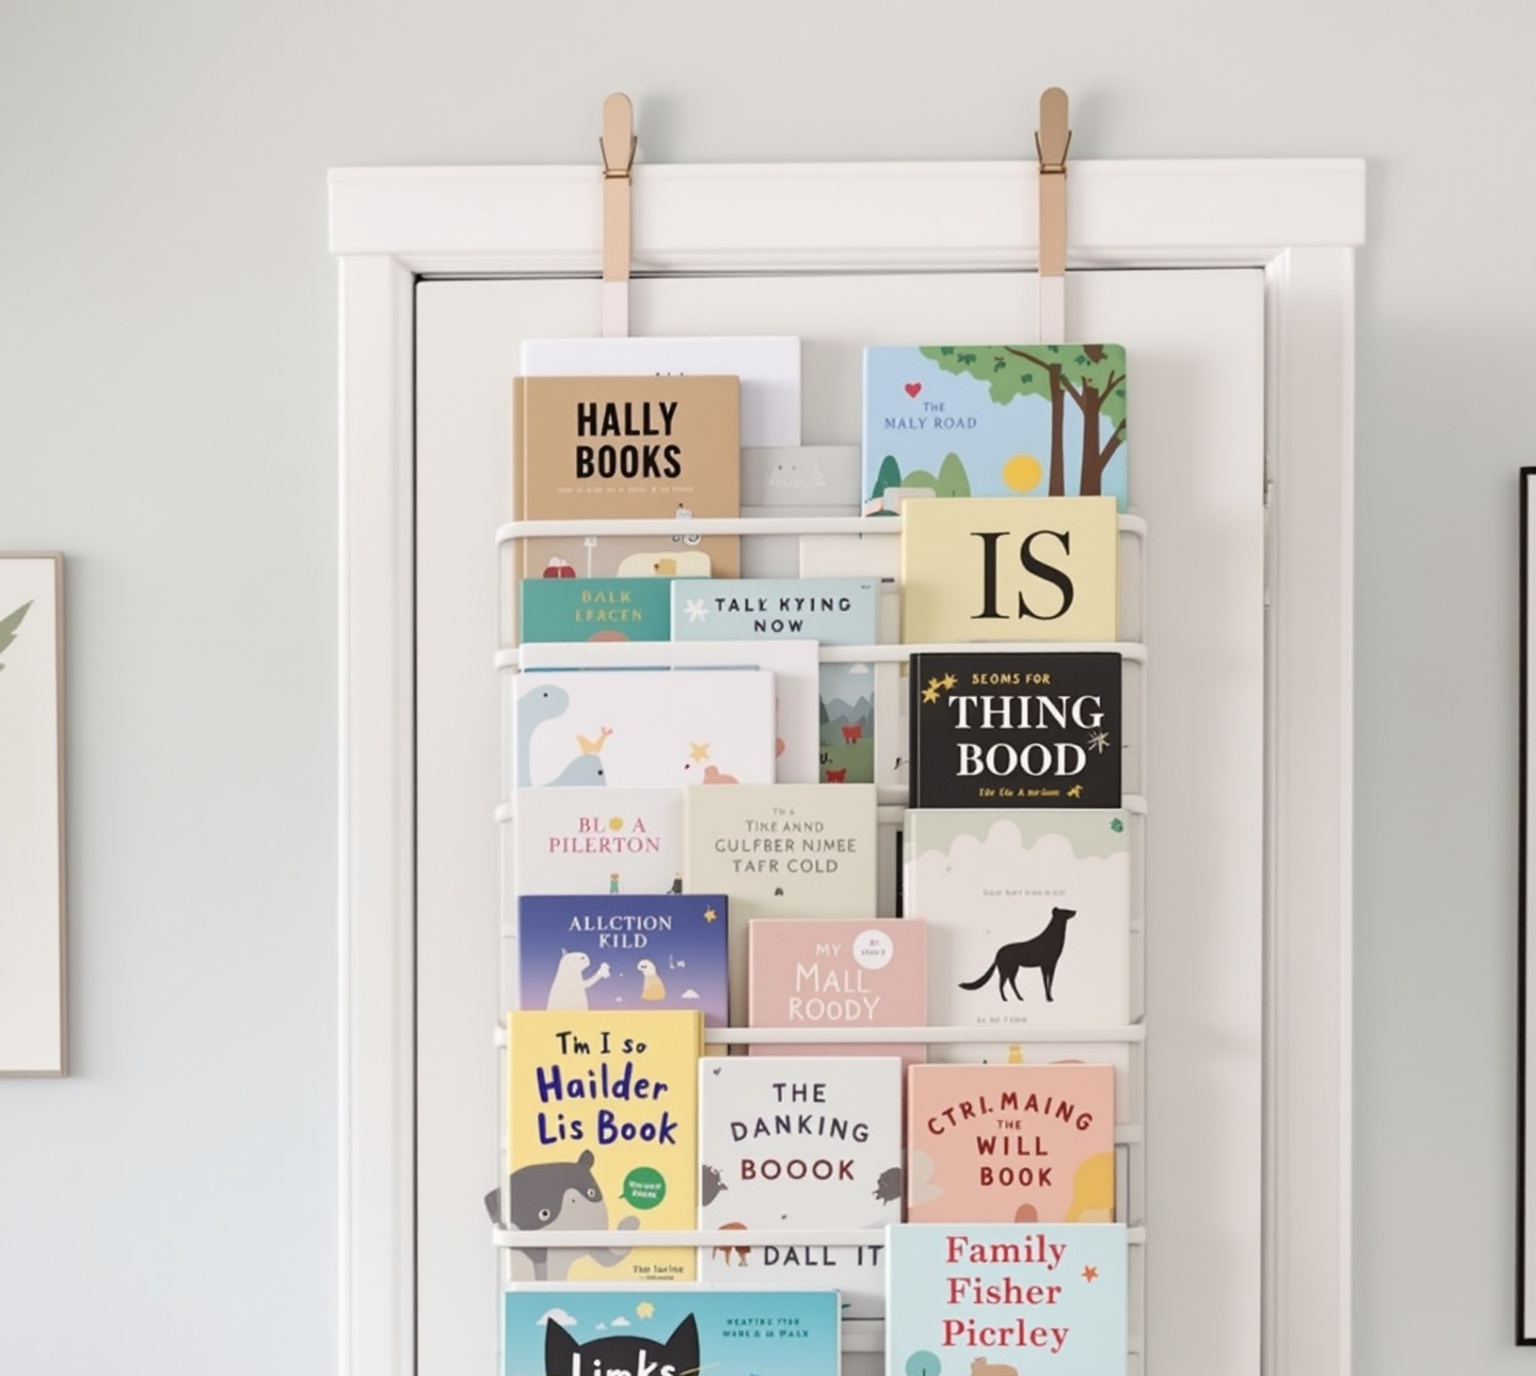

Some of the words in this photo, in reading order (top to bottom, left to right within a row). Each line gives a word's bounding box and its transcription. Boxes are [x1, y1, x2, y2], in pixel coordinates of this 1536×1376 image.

[923, 402, 945, 412] THE
[578, 402, 677, 436] HALLY
[885, 418, 927, 429] MALY
[934, 417, 977, 429] ROAD
[576, 445, 681, 478] BOOKS
[971, 530, 1074, 620] IS
[780, 598, 850, 611] KYING
[754, 619, 803, 632] NOW
[1026, 674, 1050, 684] FOR
[949, 696, 1104, 728] THING
[957, 743, 1086, 776] BOOD
[550, 837, 660, 853] PILERTON
[787, 859, 838, 873] COLD
[569, 916, 671, 931] ALLCTION
[600, 934, 647, 948] KILD
[816, 943, 841, 956] MY
[796, 962, 871, 993] MALL
[789, 996, 880, 1020] ROODY
[601, 1032, 610, 1054] I
[537, 1061, 668, 1103] Hailder
[773, 1083, 826, 1103] THE
[538, 1113, 583, 1145] Lis
[598, 1109, 677, 1144] Book
[731, 1115, 868, 1142] DANKING
[997, 1120, 1021, 1130] THE
[977, 1136, 1048, 1156] WILL
[742, 1159, 854, 1180] BOOOK
[981, 1167, 1051, 1187] BOOK
[764, 1248, 836, 1266] DALL
[858, 1248, 882, 1266] IT
[947, 1234, 1066, 1270] Family
[947, 1277, 1061, 1304] Fisher
[943, 1319, 1069, 1353] Picrley
